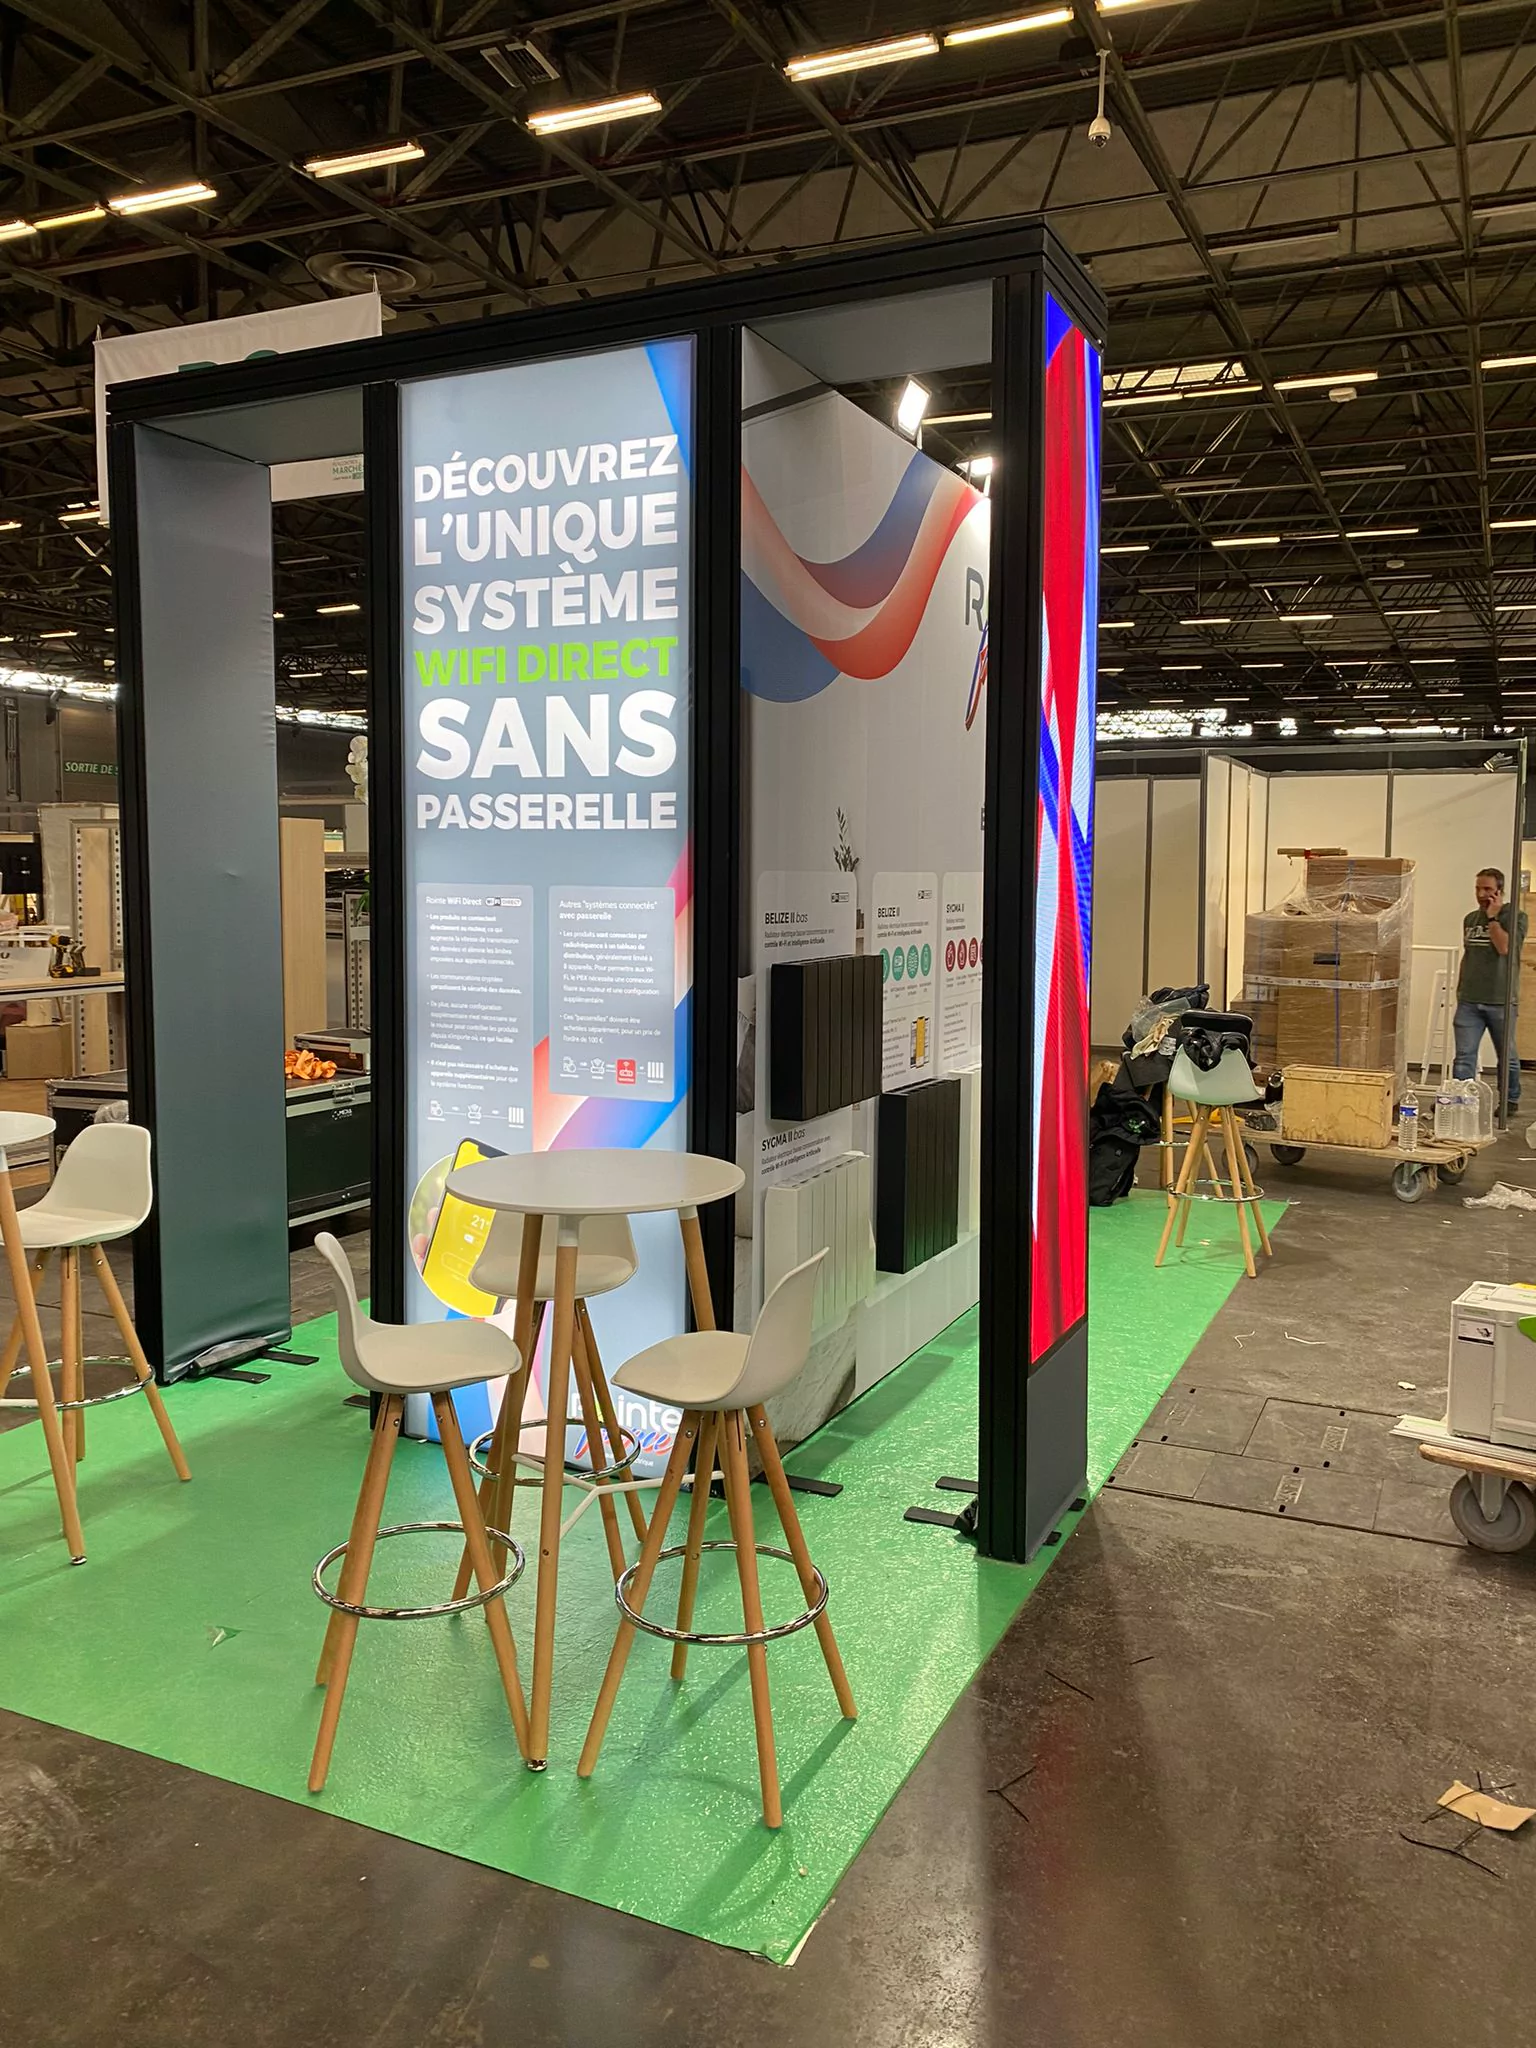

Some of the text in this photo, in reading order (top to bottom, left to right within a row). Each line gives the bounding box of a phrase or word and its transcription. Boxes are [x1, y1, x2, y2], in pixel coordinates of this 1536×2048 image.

[413, 434, 678, 502] DÉCOUVREZ
[414, 491, 677, 566] L'UNIQUE
[412, 561, 678, 634] SYSTÈME
[414, 636, 678, 687] WIFI DIRECT
[416, 689, 677, 780] SANS
[65, 762, 98, 773] SORTIE
[101, 764, 113, 774] DE
[416, 792, 677, 829] PASSERELLE
[765, 912, 789, 924] BELIZE
[796, 911, 808, 923] bas
[762, 1134, 786, 1151] SYGMA
